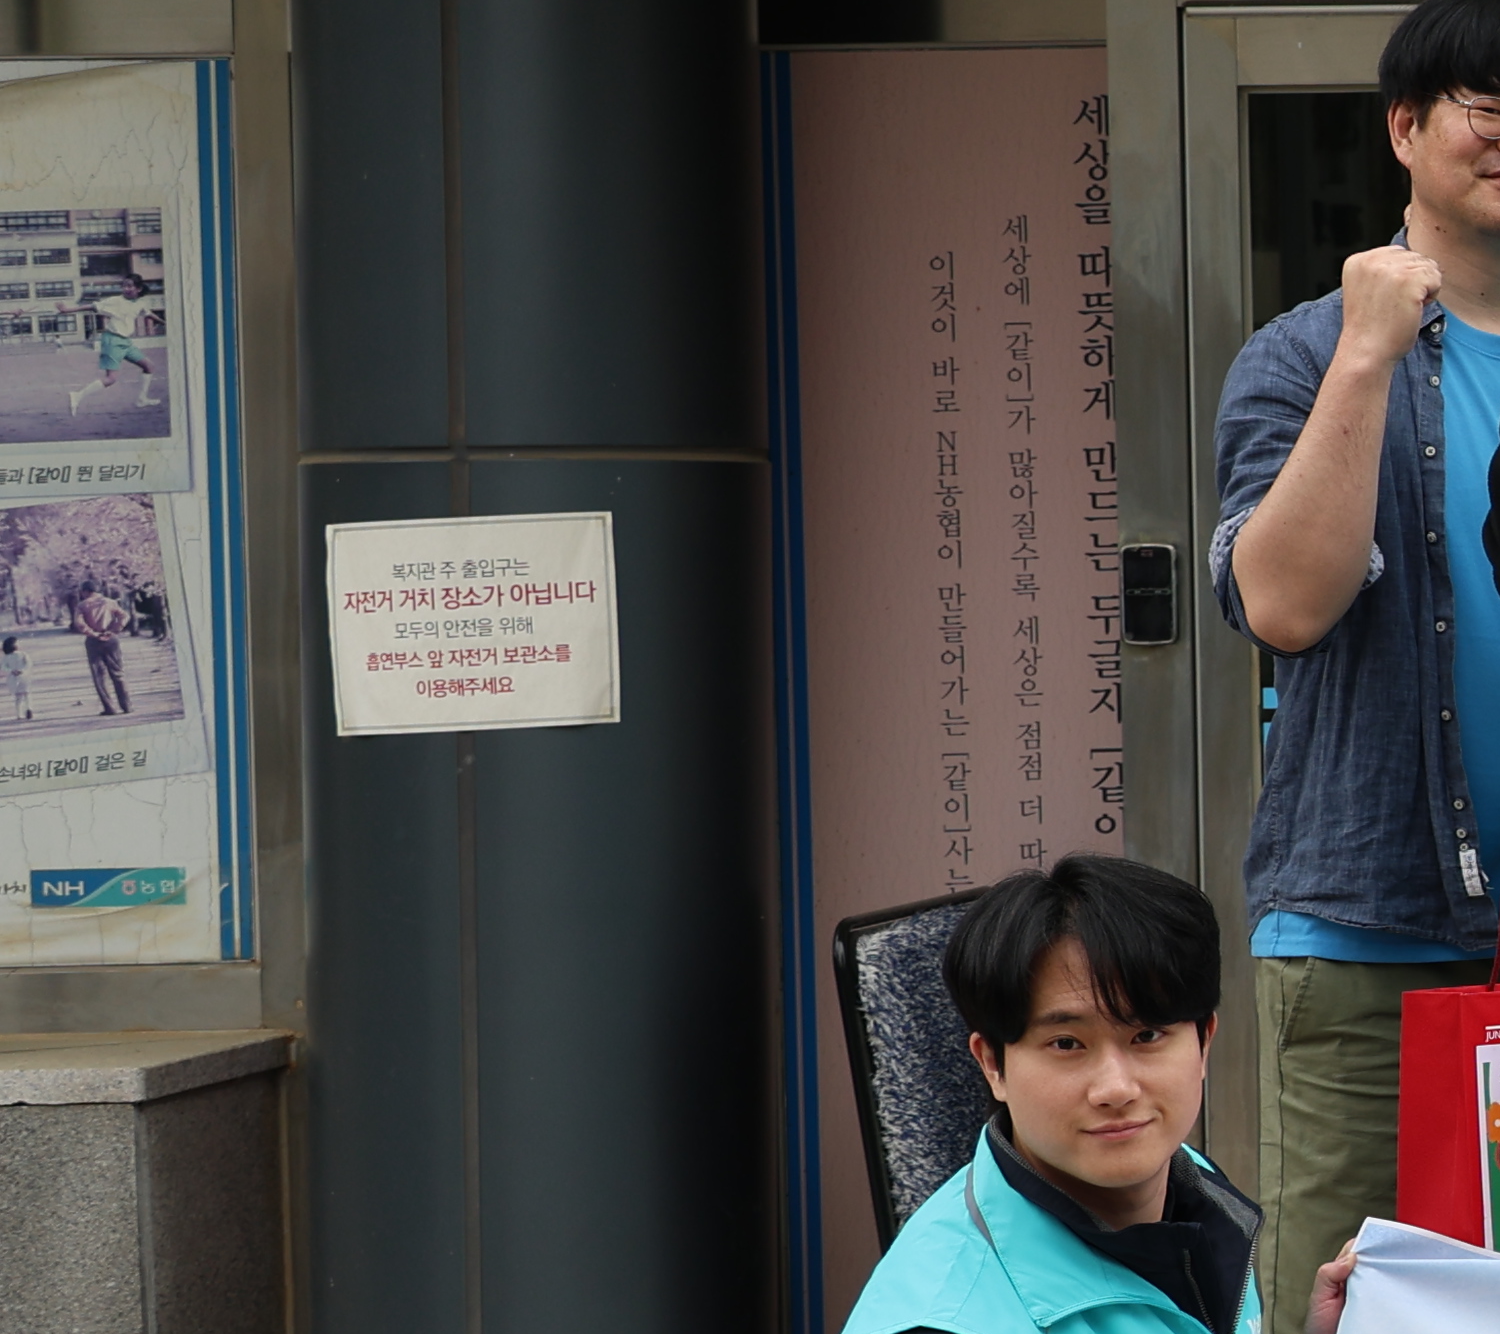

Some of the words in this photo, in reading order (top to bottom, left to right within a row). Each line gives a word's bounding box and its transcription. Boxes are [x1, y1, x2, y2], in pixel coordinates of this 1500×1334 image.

[1073, 94, 1111, 225] 세상을
[1001, 213, 1032, 307] 세상에
[929, 251, 957, 343] 이것이
[1078, 247, 1116, 421] 따뜻하게
[931, 356, 961, 414] 바로
[99, 464, 146, 481] 달리기
[1008, 448, 1041, 602] 많아질수록
[392, 563, 435, 582] 복지관
[440, 562, 456, 579] 주
[462, 558, 529, 578] 출입구는
[344, 590, 393, 614] 자전거
[399, 588, 434, 611] 거치
[440, 585, 504, 610] 장소가
[510, 580, 596, 606] 아닙니다
[394, 621, 439, 640] 모두의
[444, 618, 493, 638] 안전을
[500, 616, 533, 635] 위해
[366, 652, 424, 672] 흡연부스
[428, 650, 444, 669] 앞
[448, 648, 497, 666] 자전거
[503, 644, 572, 664] 보관소를
[937, 582, 970, 737] 만들어가는
[1013, 615, 1044, 708] 세상은
[416, 677, 514, 698] 이용해주세요
[96, 752, 125, 771] 걸은
[132, 749, 147, 767] 길
[1017, 721, 1043, 782] 점점
[1018, 794, 1044, 826] 더
[42, 880, 84, 896] NH
